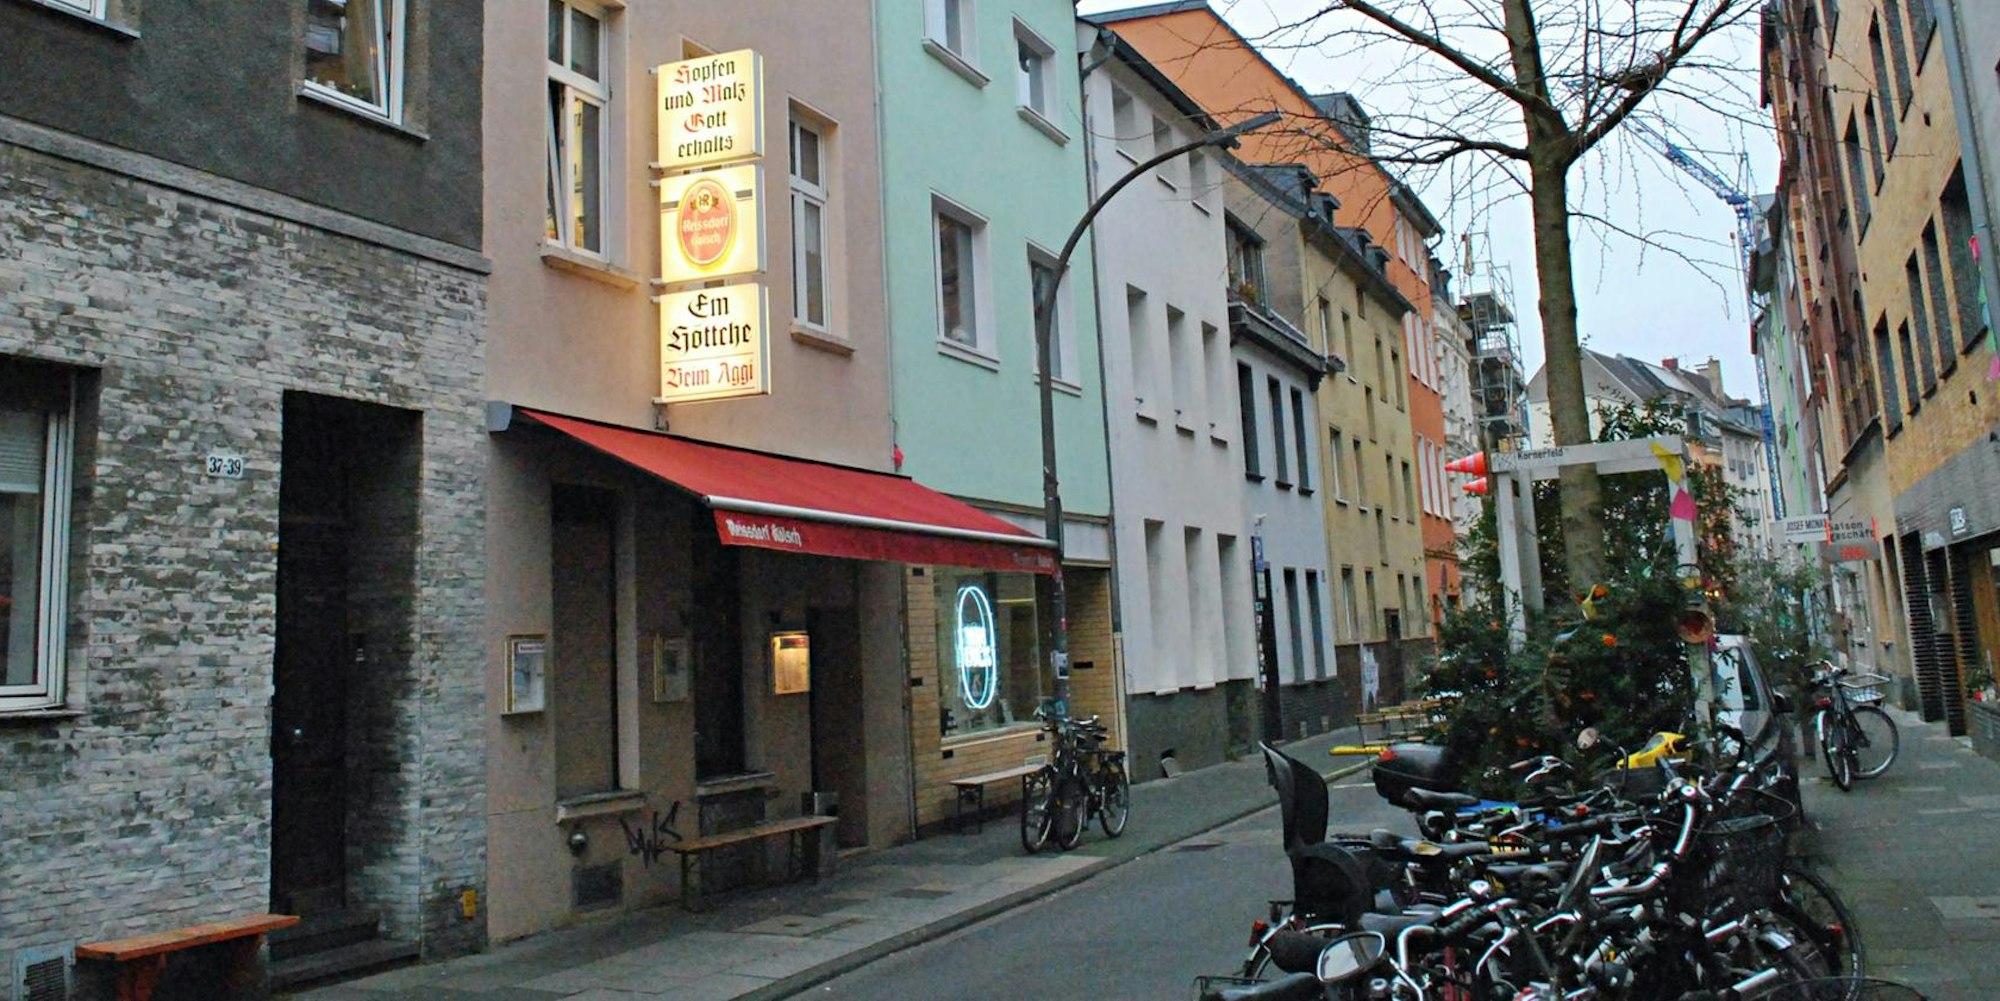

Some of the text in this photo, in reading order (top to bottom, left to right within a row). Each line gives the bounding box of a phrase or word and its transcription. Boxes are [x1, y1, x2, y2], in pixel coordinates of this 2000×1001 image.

[674, 59, 735, 84] Hopfen
[665, 82, 746, 110] und Malz
[684, 110, 728, 133] Gott
[688, 293, 729, 318] Em
[667, 360, 754, 388] Beim Aggi
[209, 456, 241, 475] 37-39
